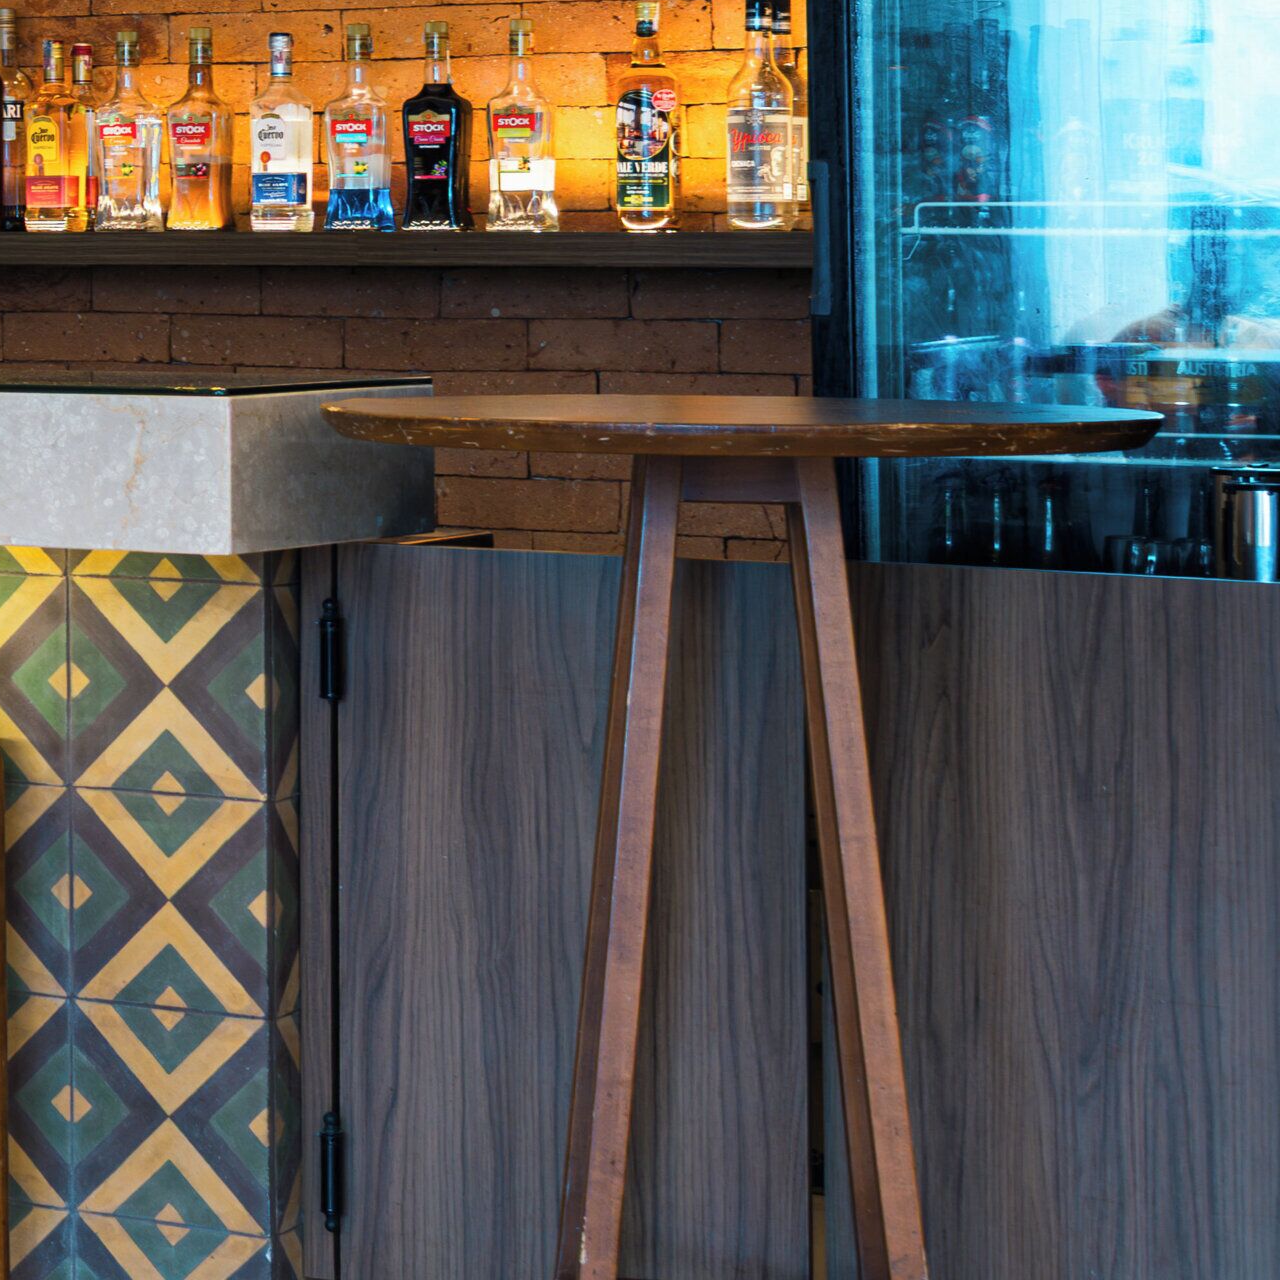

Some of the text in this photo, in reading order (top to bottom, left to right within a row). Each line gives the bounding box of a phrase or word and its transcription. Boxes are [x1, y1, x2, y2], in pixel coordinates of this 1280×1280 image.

[497, 117, 529, 126] STOCK
[103, 125, 132, 135] STOCK
[175, 125, 205, 134] STOCK
[335, 123, 366, 132] STOCK
[413, 124, 445, 132] STOCK
[634, 161, 668, 173] VERDE
